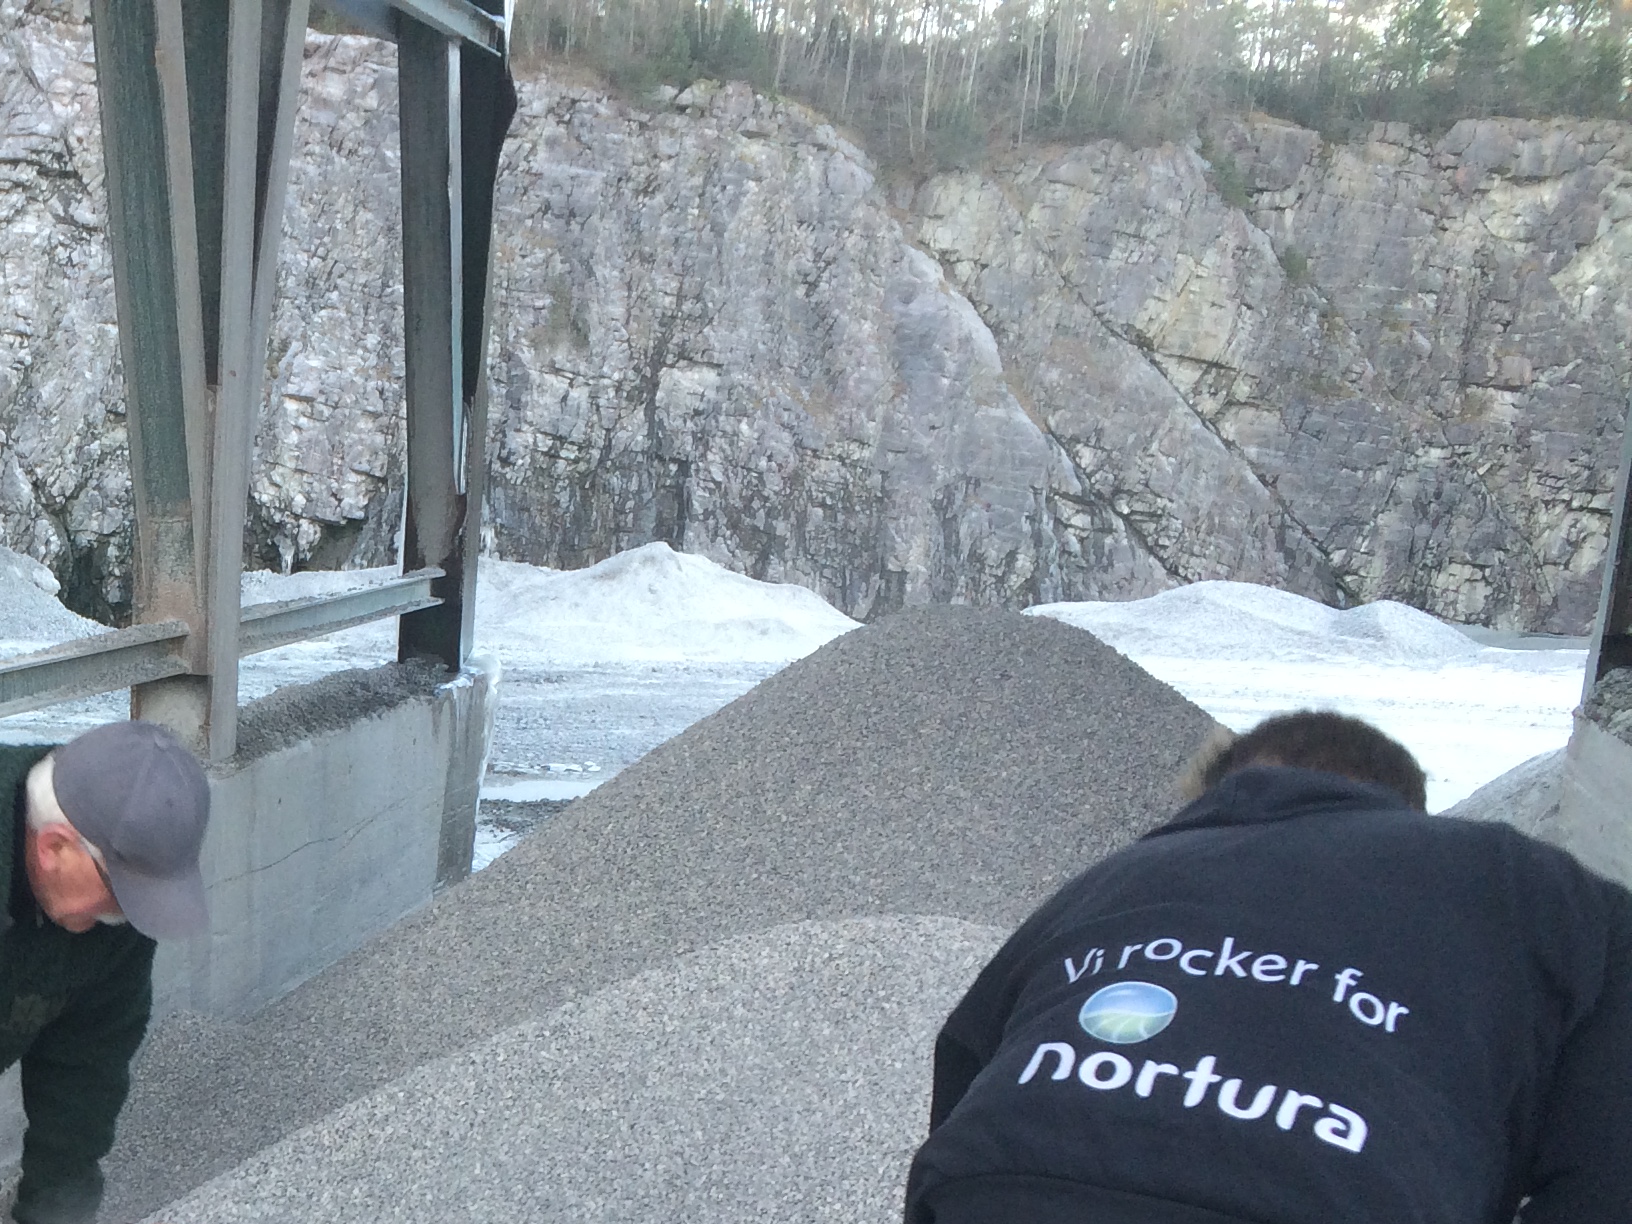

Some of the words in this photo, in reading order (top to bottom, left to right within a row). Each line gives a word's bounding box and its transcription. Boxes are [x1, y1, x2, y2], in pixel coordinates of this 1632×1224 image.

[1064, 947, 1105, 984] Vi
[1118, 936, 1320, 986] rocker
[1332, 968, 1410, 1033] for
[1017, 1041, 1369, 1153] nortura
